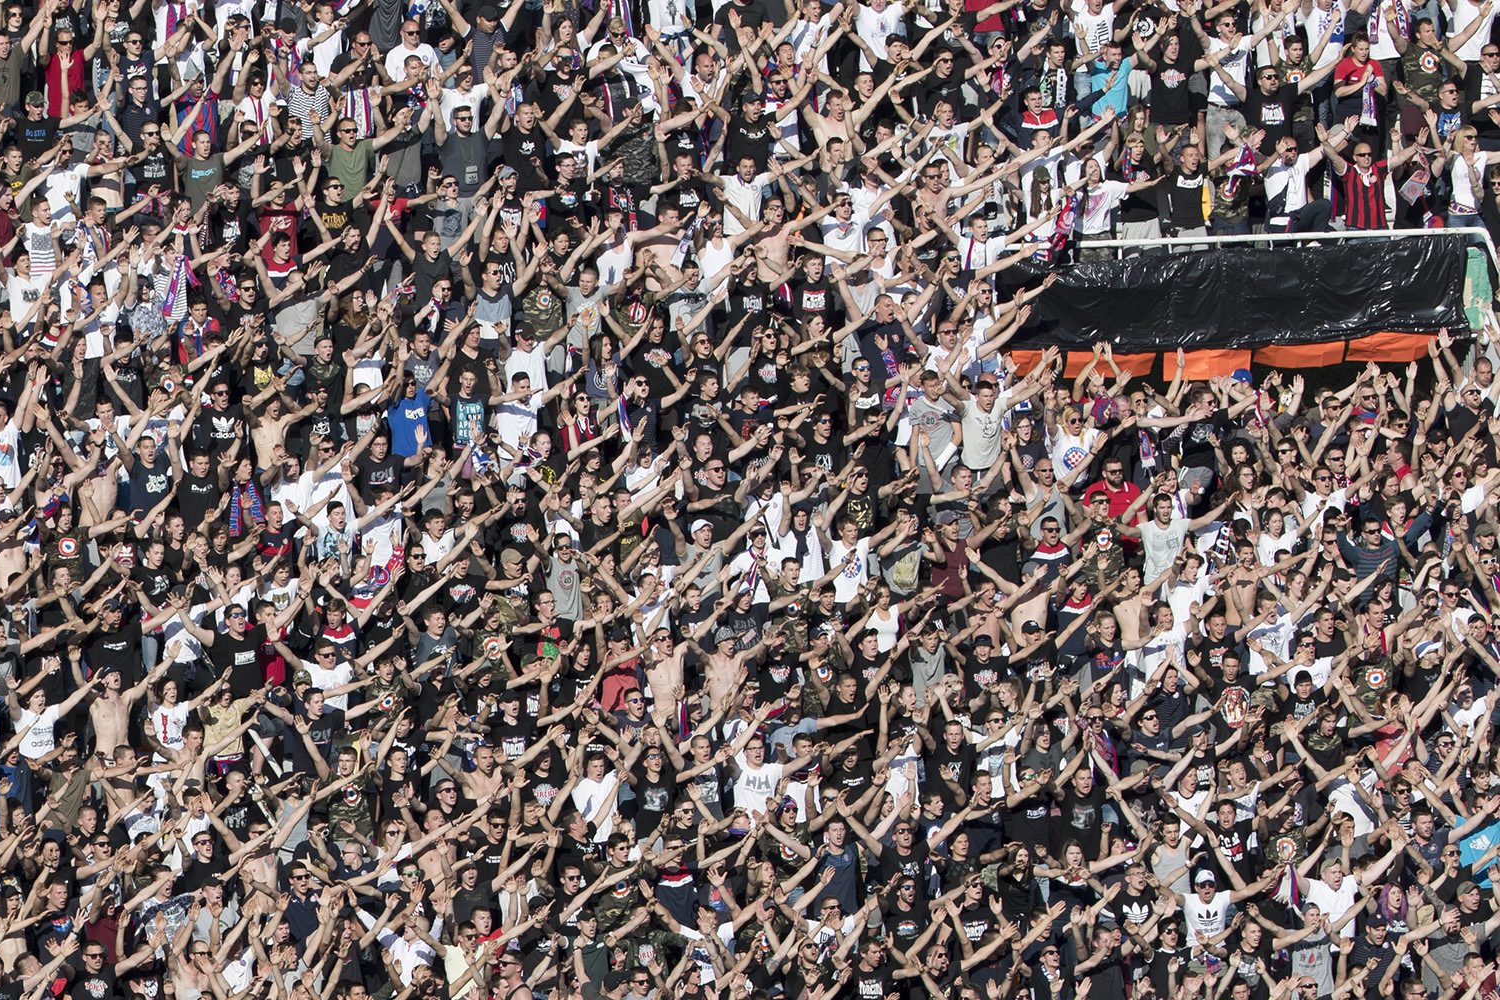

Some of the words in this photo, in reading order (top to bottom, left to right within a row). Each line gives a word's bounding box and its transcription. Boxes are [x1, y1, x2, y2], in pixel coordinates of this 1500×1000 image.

[1261, 108, 1284, 121] TORCIDA
[211, 431, 236, 439] adidas
[858, 983, 884, 995] TORCIDA
